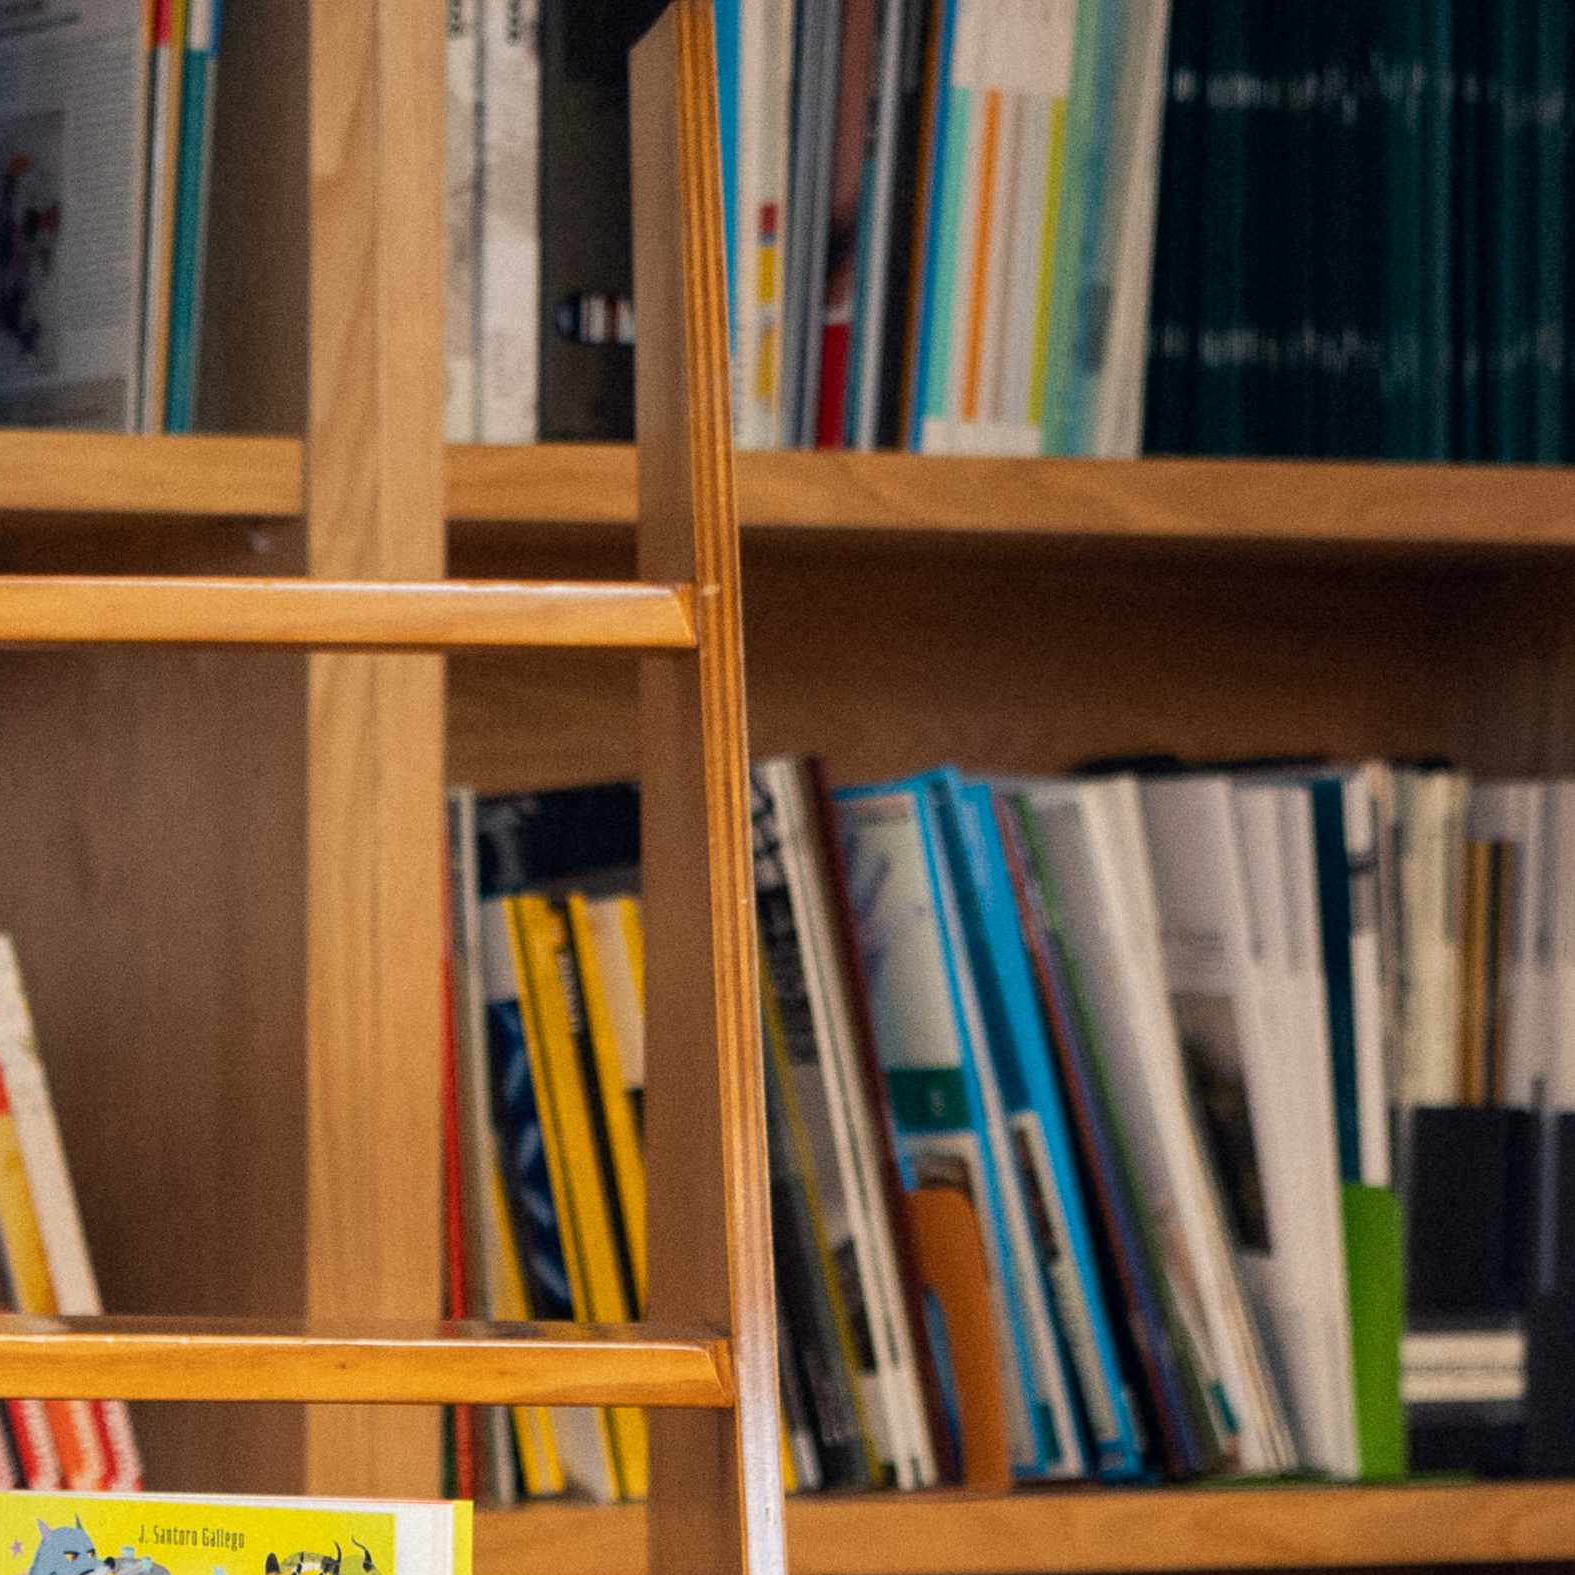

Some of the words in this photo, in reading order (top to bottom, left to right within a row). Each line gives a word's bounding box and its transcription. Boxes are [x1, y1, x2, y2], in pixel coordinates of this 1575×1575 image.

[138, 1524, 148, 1543] J.
[153, 1525, 198, 1546] Santoro
[202, 1528, 245, 1551] Gallego
